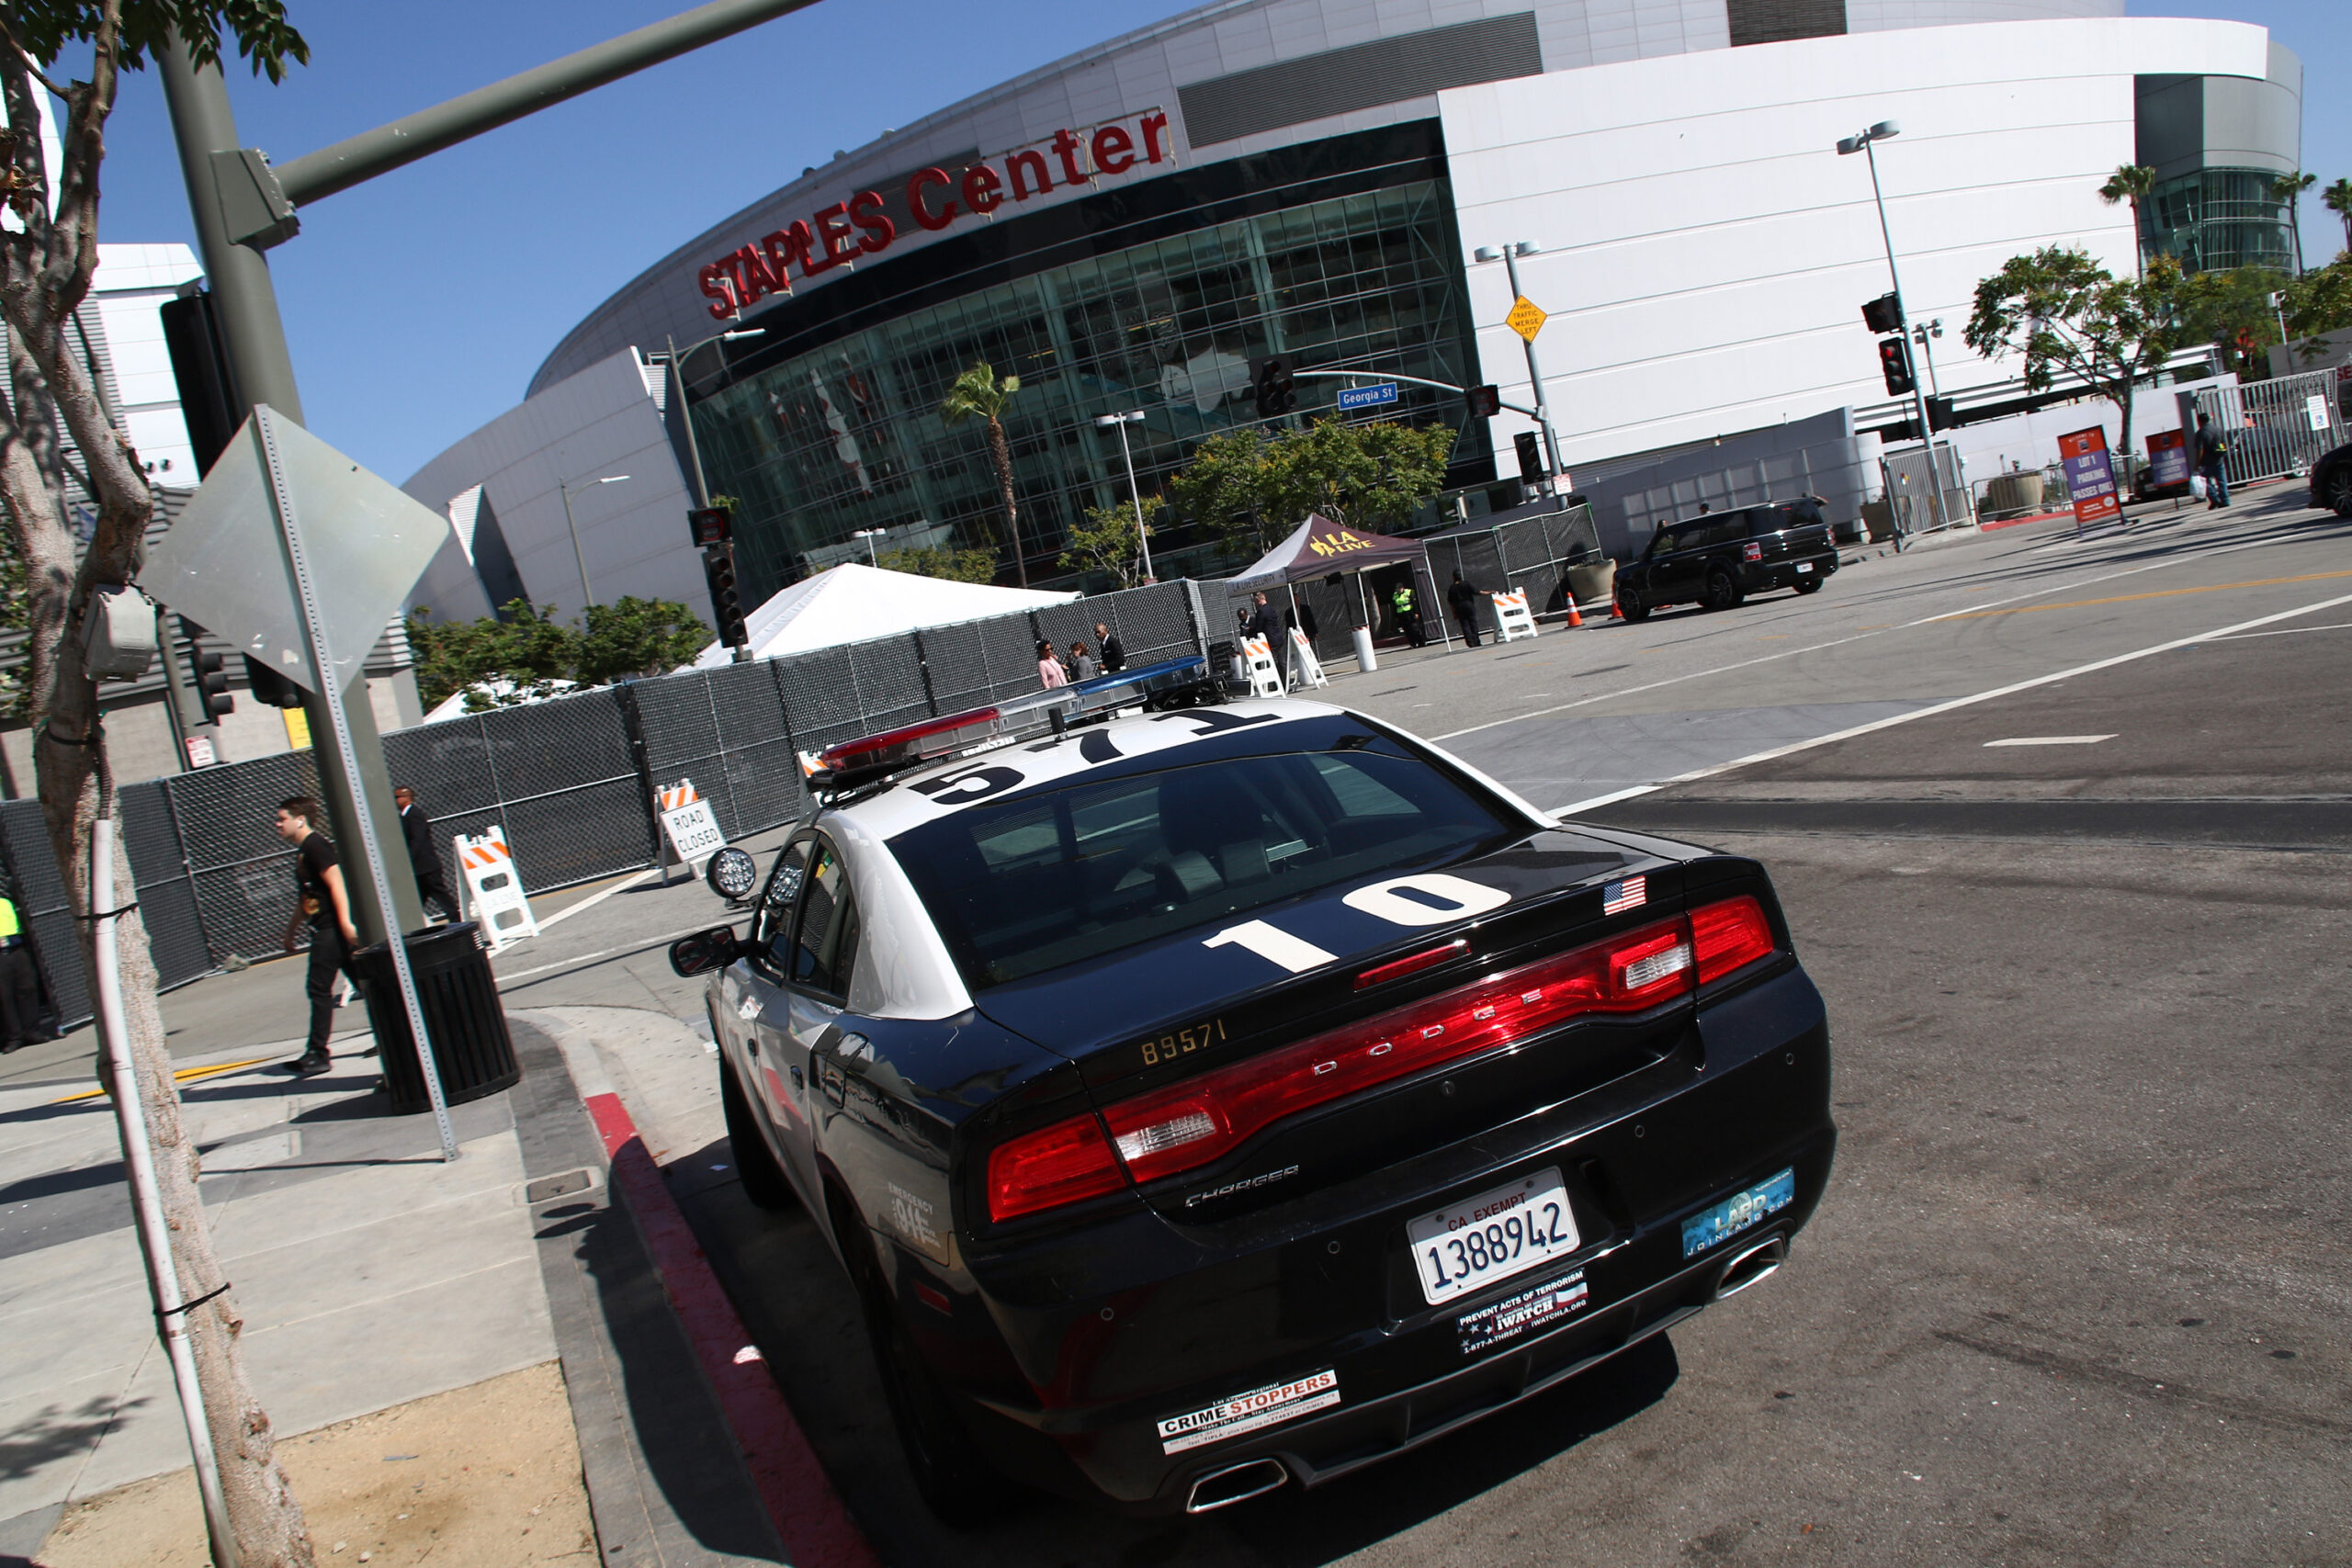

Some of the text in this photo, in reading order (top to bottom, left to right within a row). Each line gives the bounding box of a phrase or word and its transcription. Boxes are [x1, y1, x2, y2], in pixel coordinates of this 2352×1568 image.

[698, 111, 1168, 321] STAPLES Center
[1513, 310, 1538, 319] TRAFFIC
[1515, 318, 1539, 327] MERGE
[1521, 326, 1536, 334] LEFT
[1343, 388, 1393, 404] Georgia St
[2076, 468, 2106, 484] PARKING
[2078, 455, 2097, 468] LOT 1
[2073, 480, 2114, 501] PASSES ONLY
[1325, 531, 1360, 546] LA
[1335, 539, 1376, 552] LIVE
[673, 809, 704, 830] ROAD
[678, 829, 718, 852] CLOSED
[1201, 874, 1511, 974] 10
[1141, 1019, 1226, 1066] 89571
[1314, 988, 1542, 1076] DODGE
[888, 1181, 933, 1214] EMERGENCY
[1185, 1165, 1298, 1208] CHARGER
[1448, 1192, 1526, 1232] CA EXEMPT
[1687, 1195, 1792, 1256] JOINLADCOM
[1715, 1195, 1767, 1233] LAPD
[1429, 1201, 1567, 1289] 1388942
[1460, 1270, 1584, 1325] PREVENT ACTS OF TERRORISM
[1497, 1299, 1554, 1331] iWATCH
[1464, 1325, 1522, 1354] 1-877-A-THREAT
[1164, 1373, 1330, 1433] CRIME STOPPERS
[1252, 1382, 1280, 1395] Regional
